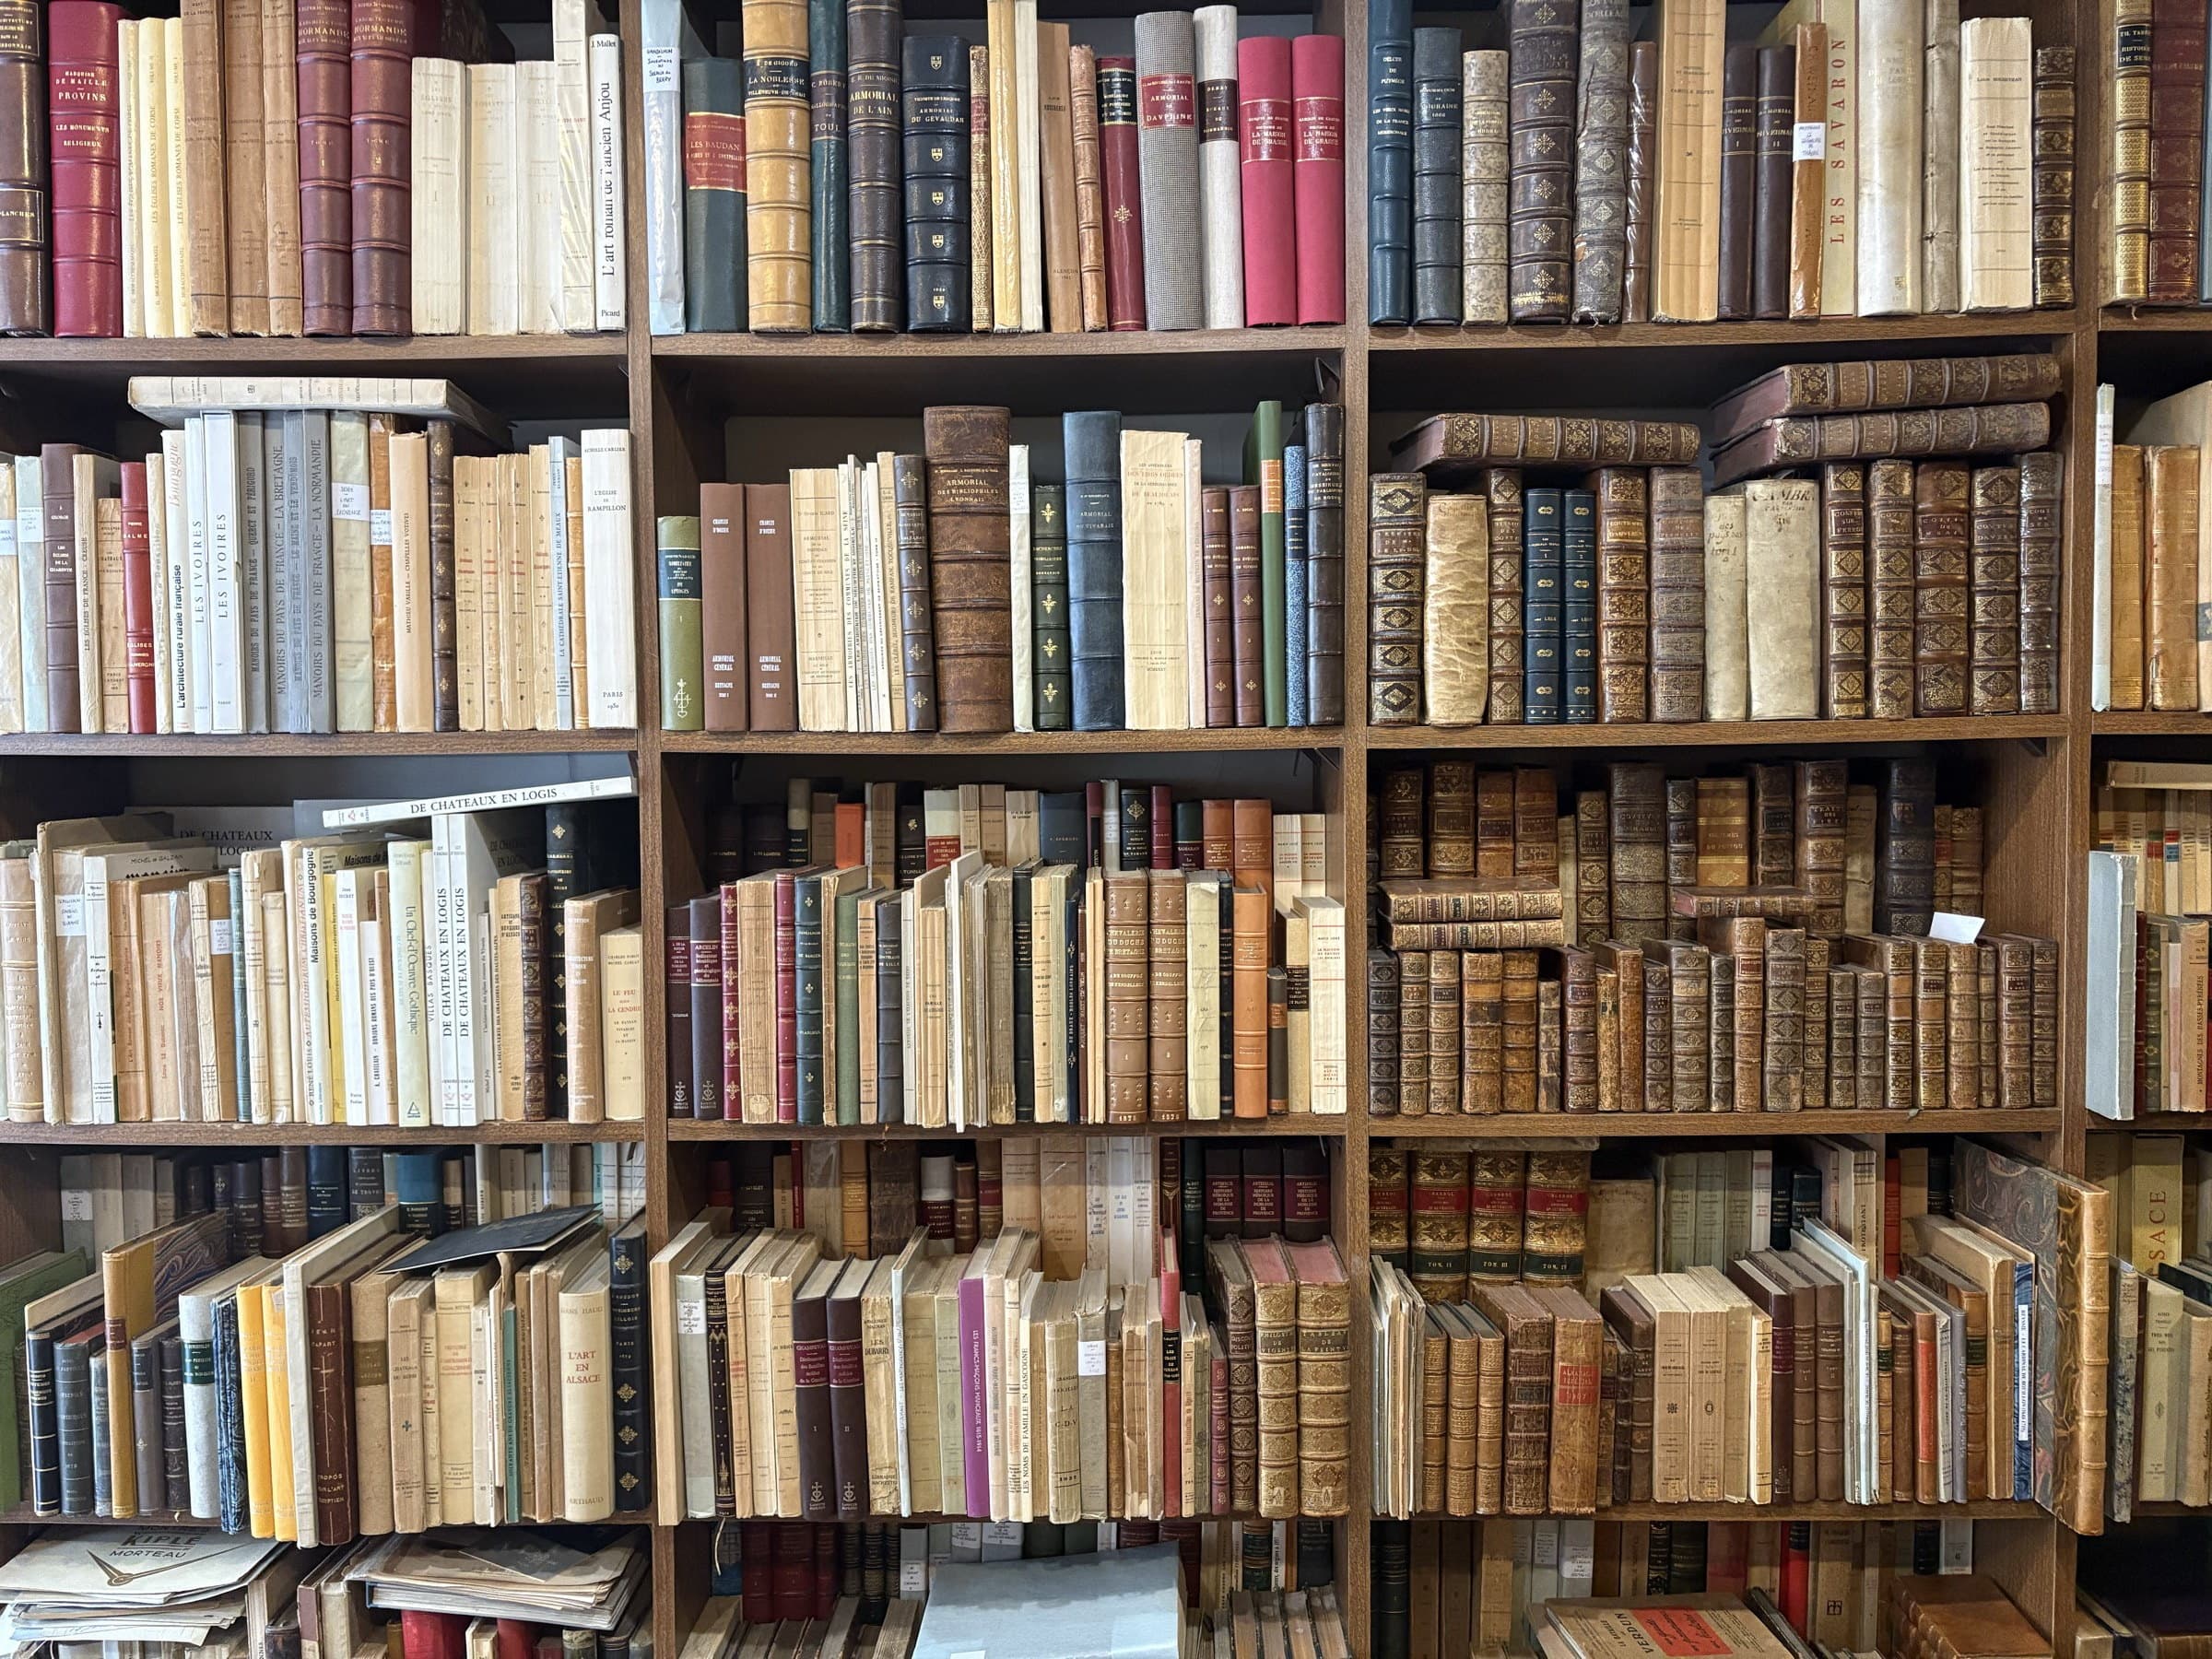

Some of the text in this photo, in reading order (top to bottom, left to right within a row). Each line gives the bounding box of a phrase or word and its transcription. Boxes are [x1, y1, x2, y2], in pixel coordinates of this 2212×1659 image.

[58, 91, 107, 101] PROVINS
[599, 81, 612, 120] Anjou
[850, 90, 897, 102] ARMORIAL
[853, 106, 864, 114] DE
[814, 124, 839, 132] TOUL
[1829, 38, 1845, 244] LES SAVARON
[601, 179, 613, 194] de
[603, 197, 613, 238] roman
[601, 309, 620, 318] Picard
[946, 478, 989, 487] ARMORIAL
[192, 519, 204, 623] LES IVOIRES
[216, 512, 228, 618] LES IVOIRES
[272, 445, 287, 695] MANOIRS DU PAYS DE FRANCE LA BRETAGNE
[312, 439, 324, 698] MANOIRS DU PAYS DE FRANCE LA NORMANDIE
[172, 564, 186, 708] L'architecture rurale française
[410, 788, 558, 814] DE CHATEAUX EN LOGIS
[202, 830, 274, 841] CHATEAUX
[305, 851, 319, 963] Maisons de Bourgogne
[406, 906, 416, 917] Un
[437, 888, 452, 1037] DE CHATEAUX EN LOGIS
[454, 888, 469, 1037] DE CHATEAUX EN LOGIS
[406, 990, 420, 1035] Gothique
[582, 1306, 604, 1314] HAUG
[971, 1329, 980, 1340] LES
[568, 1350, 596, 1360] L'ART
[575, 1363, 589, 1371] EN
[972, 1341, 981, 1391] FRANCS-MAÇONS
[1020, 1347, 1029, 1390] GASCOGNE
[566, 1374, 600, 1384] ALSACE
[1020, 1393, 1029, 1404] EN
[1021, 1406, 1030, 1439] FAMILLE
[1021, 1441, 1030, 1453] DE
[110, 1549, 187, 1559] MORTEAU
[1614, 1612, 1652, 1653] VERDUN
